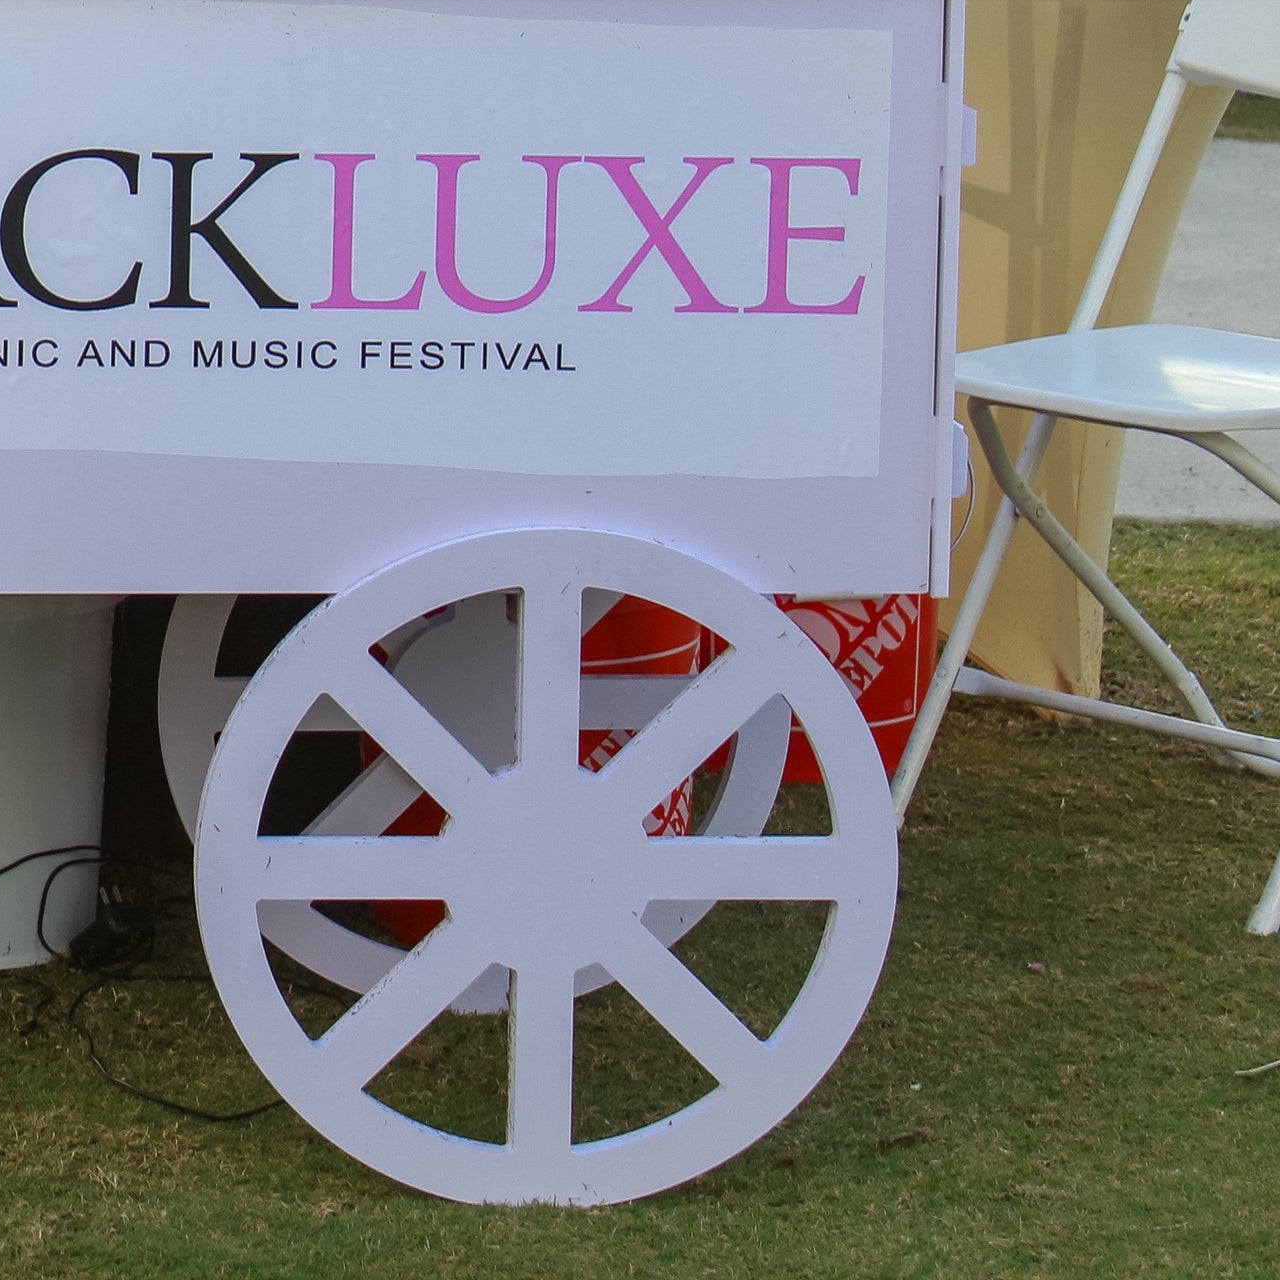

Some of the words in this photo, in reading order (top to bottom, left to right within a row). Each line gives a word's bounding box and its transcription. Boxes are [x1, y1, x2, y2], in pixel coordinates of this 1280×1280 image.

[76, 338, 171, 368] AND
[192, 339, 338, 370] MUSIC
[359, 340, 576, 372] FESTIVAL
